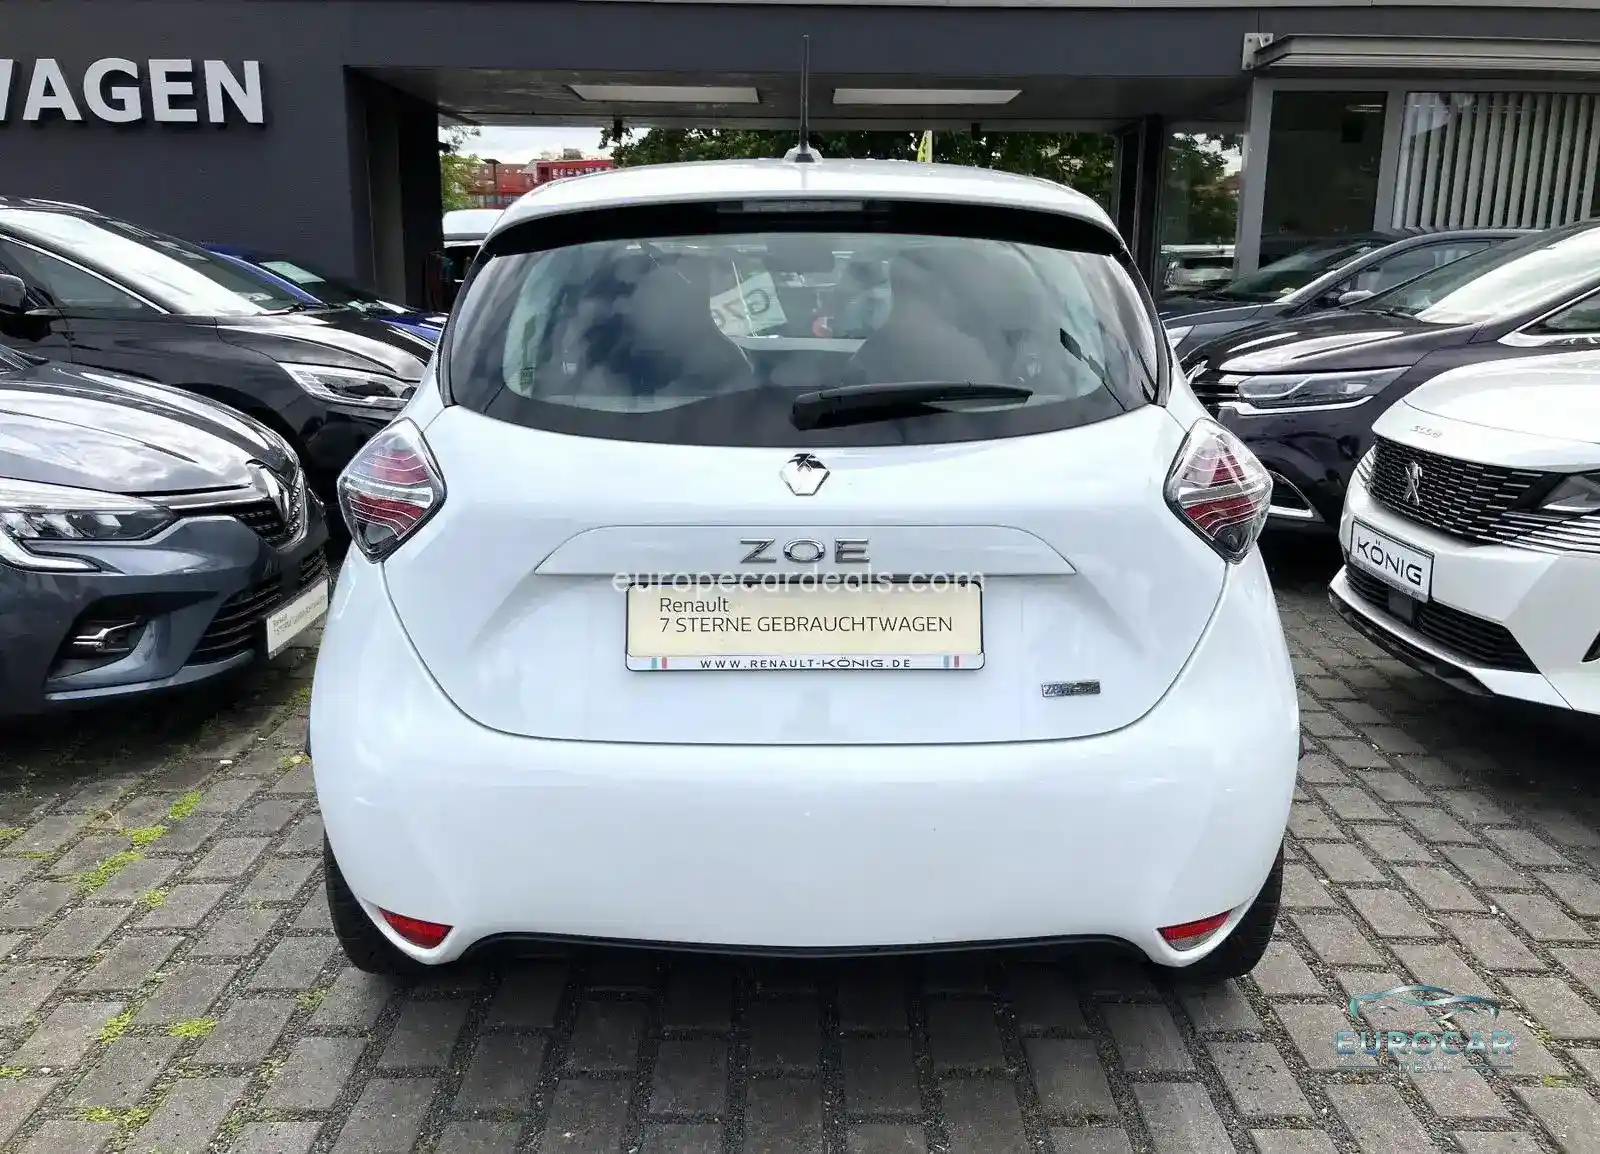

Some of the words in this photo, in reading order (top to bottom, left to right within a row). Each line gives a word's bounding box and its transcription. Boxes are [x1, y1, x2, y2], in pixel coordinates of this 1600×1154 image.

[739, 537, 871, 563] ZOE
[1356, 536, 1423, 586] KÖNIG
[659, 596, 730, 613] Renault
[660, 617, 670, 633] 7
[676, 617, 752, 633] STERNE
[757, 616, 953, 633] GEBRAUCHTWAGEN
[700, 656, 912, 668] WWW.RENAULT-KÖNIG.DE
